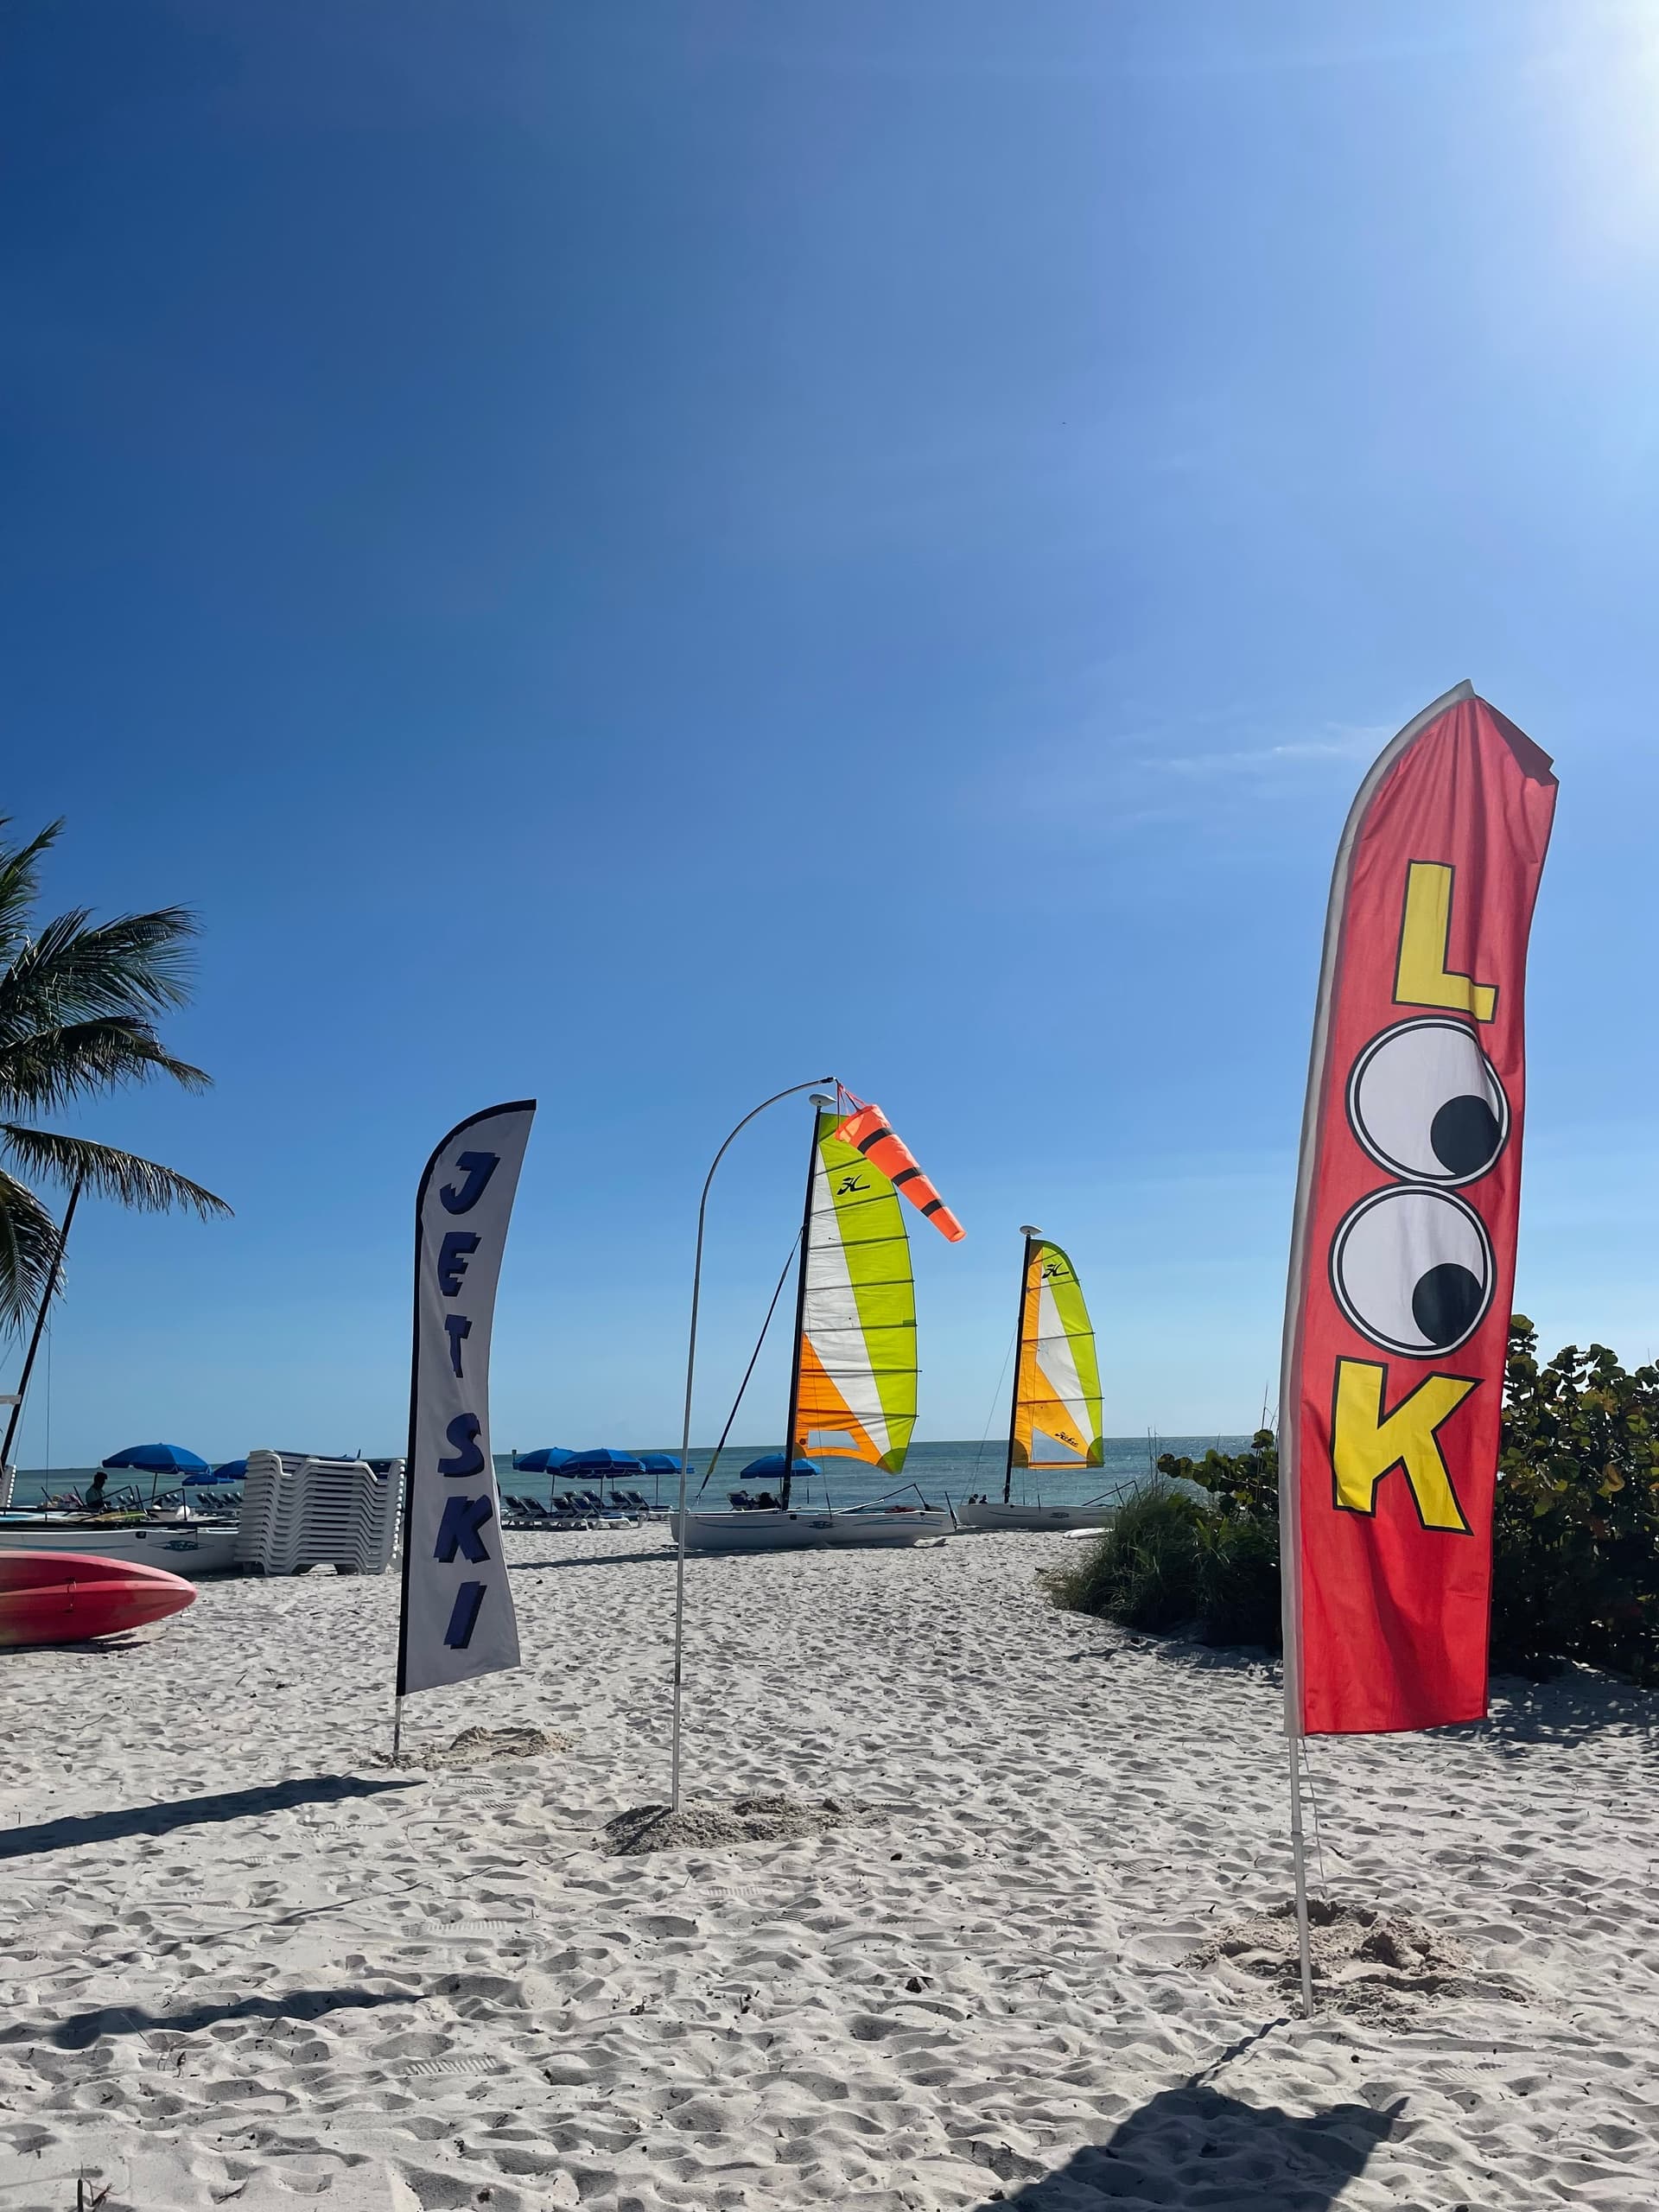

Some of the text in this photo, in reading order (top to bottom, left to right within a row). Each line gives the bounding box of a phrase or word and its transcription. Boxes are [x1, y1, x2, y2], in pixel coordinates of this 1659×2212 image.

[433, 1151, 501, 1649] JET SKI
[1329, 859, 1511, 1535] LOOK
